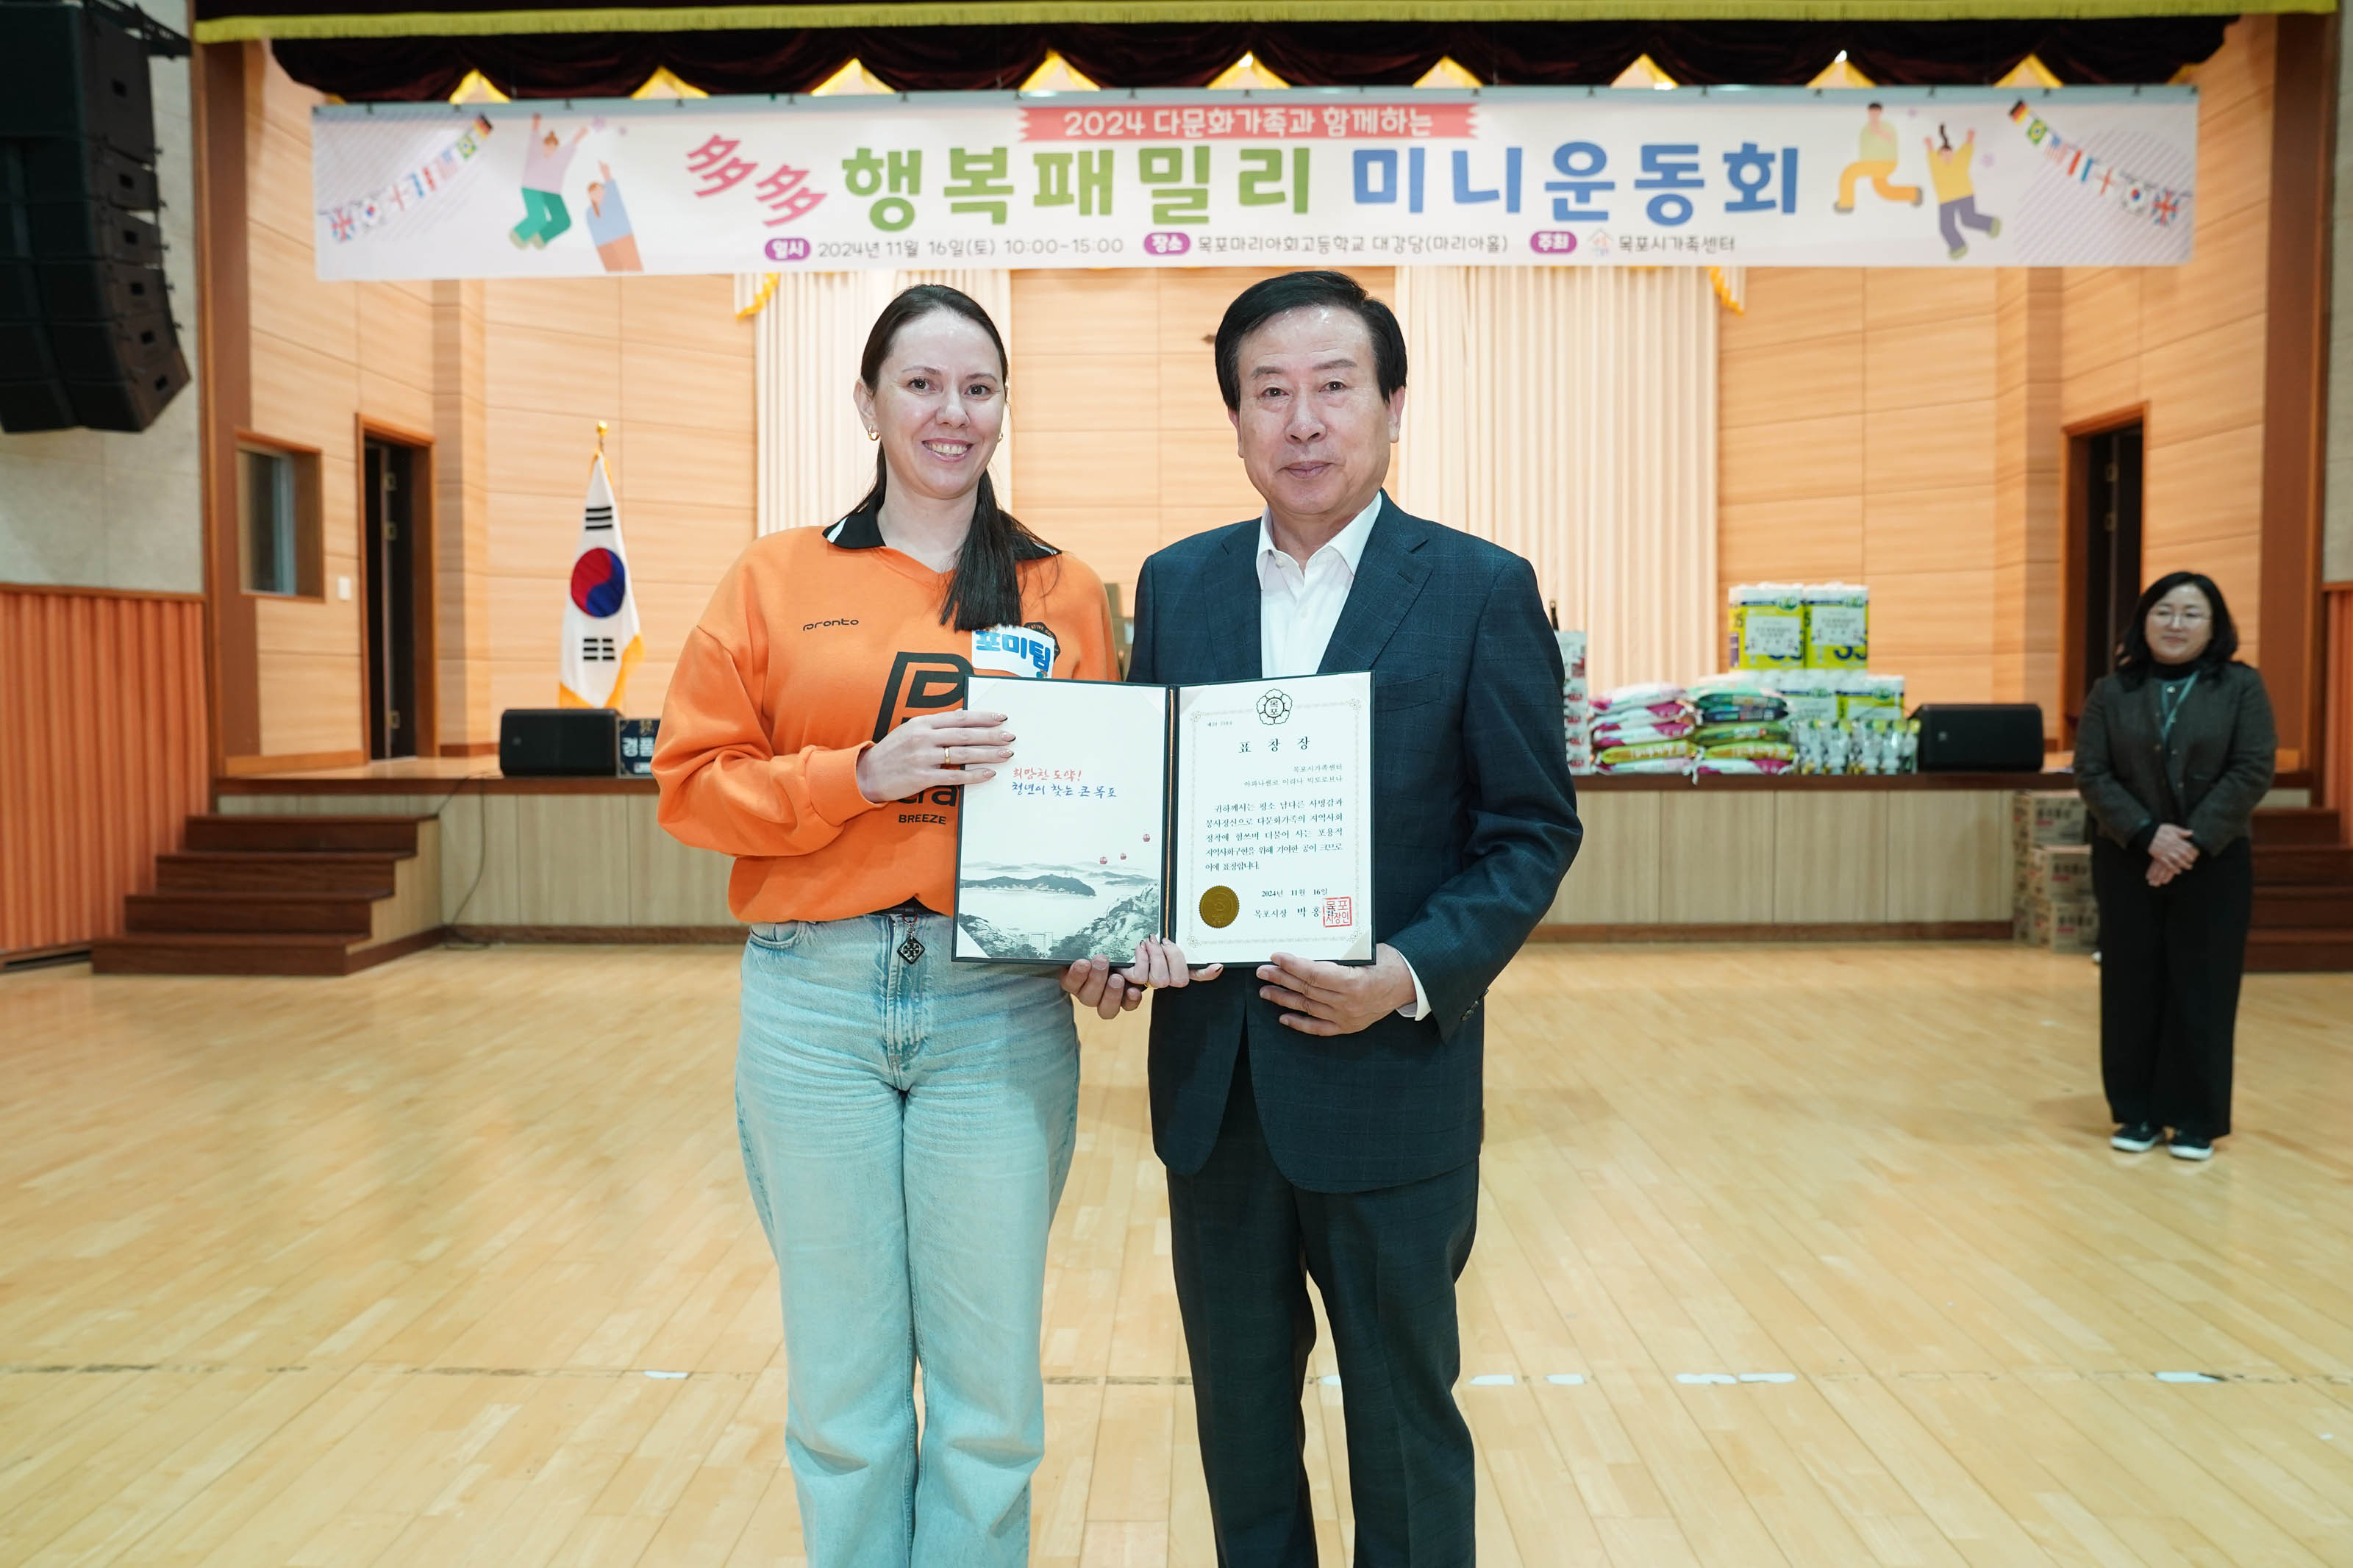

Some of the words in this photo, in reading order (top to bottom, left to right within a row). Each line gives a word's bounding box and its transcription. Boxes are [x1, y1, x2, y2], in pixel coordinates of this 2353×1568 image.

[1064, 110, 1146, 137] 2024
[1153, 108, 1316, 138] 다문화가족과
[1322, 107, 1434, 137] 함께하는
[686, 134, 828, 228] 多多
[842, 146, 1310, 232] 행복패밀리
[1352, 141, 1799, 226] 미니운동회
[771, 240, 805, 259] 일시
[818, 242, 880, 258] 2024년
[887, 240, 918, 258] 11월
[929, 239, 996, 257] 16일(토)
[1151, 235, 1183, 254] 장소
[1198, 235, 1365, 255] 목포마리아회고등학교
[1372, 235, 1509, 254] 대강당(마리아홀)
[1538, 232, 1571, 251] 주최
[1618, 234, 1736, 254] 목포시가족센터
[803, 618, 860, 631] pronto
[975, 631, 1051, 673] 포미팀
[1013, 767, 1049, 781] 희망찬
[1053, 770, 1082, 782] 도약!
[1012, 781, 1046, 795] 청년이
[1051, 783, 1074, 797] 찾는
[1079, 785, 1090, 798] 큰
[1093, 785, 1118, 799] 목포
[899, 814, 947, 825] BREEZE
[1261, 889, 1283, 898] 2024년
